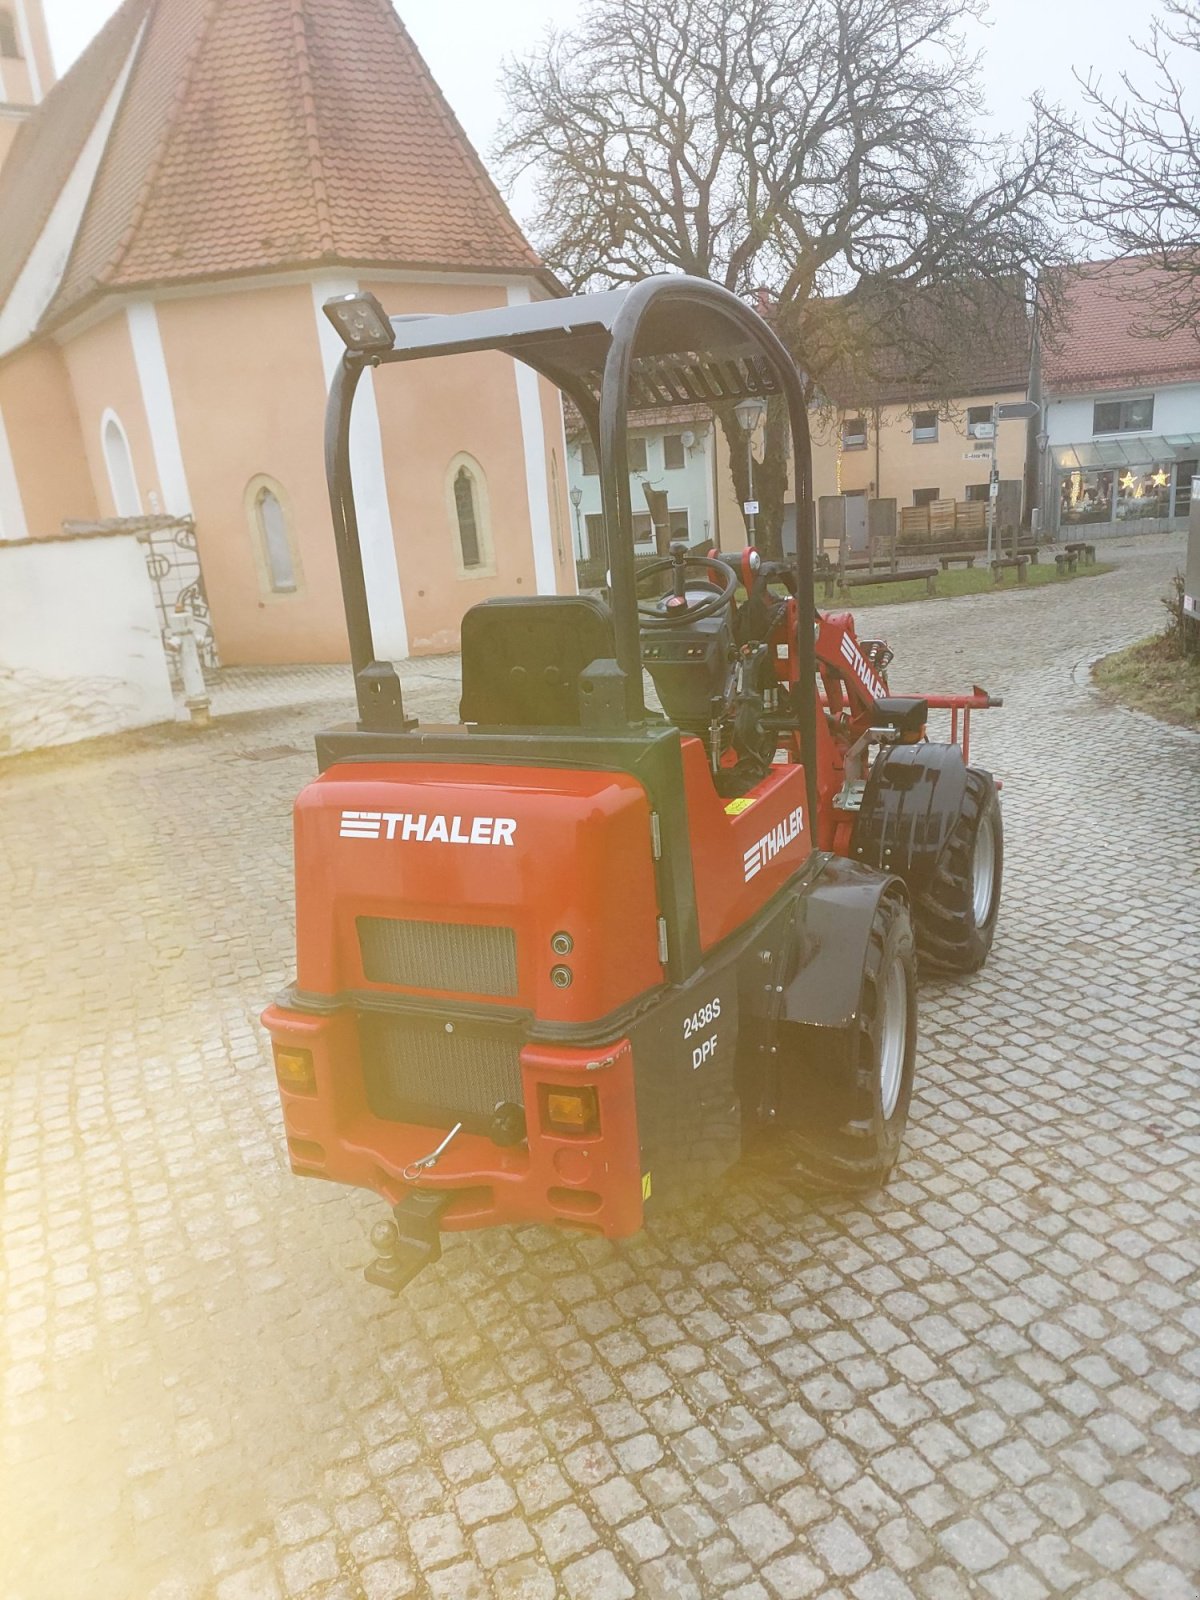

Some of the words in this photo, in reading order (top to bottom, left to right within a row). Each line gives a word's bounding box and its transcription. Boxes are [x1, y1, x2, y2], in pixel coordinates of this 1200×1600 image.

[381, 812, 517, 846] THALER
[759, 805, 804, 866] THALER
[683, 997, 721, 1040] 2438S
[692, 1033, 718, 1070] DPF
